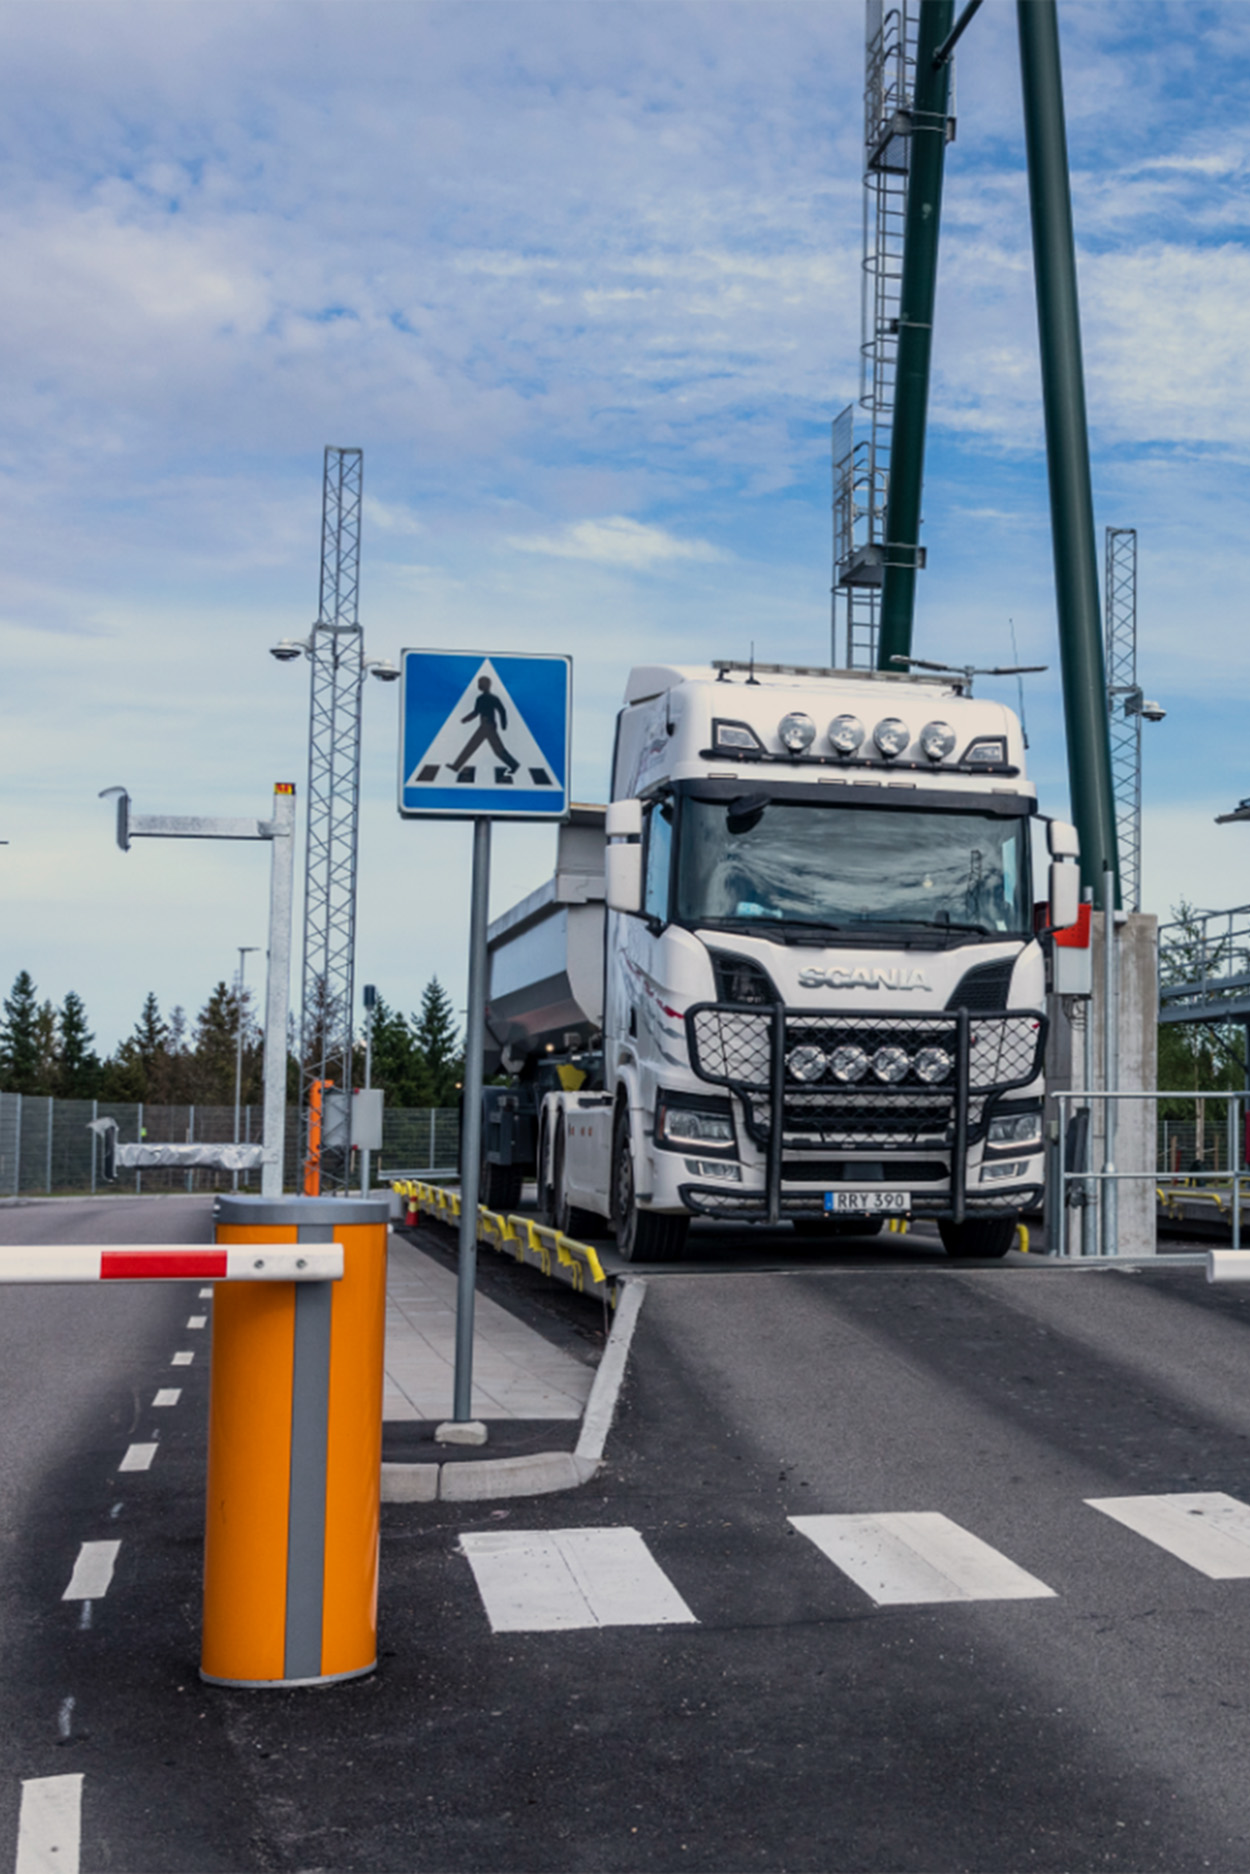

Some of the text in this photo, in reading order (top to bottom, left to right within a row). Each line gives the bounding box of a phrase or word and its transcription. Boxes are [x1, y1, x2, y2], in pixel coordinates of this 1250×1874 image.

[798, 966, 932, 992] SCANIA
[838, 1193, 904, 1208] RRY 390
